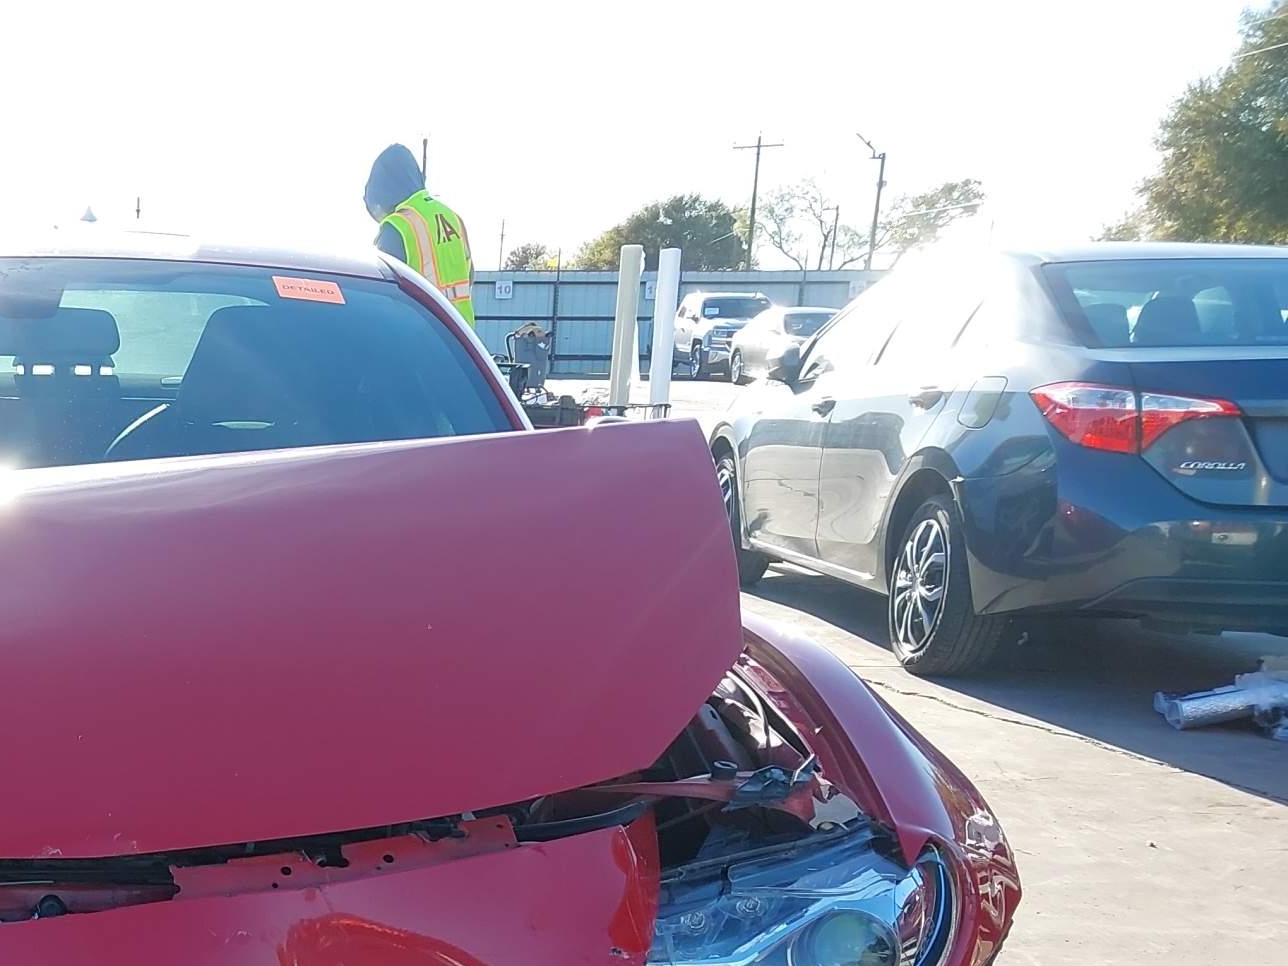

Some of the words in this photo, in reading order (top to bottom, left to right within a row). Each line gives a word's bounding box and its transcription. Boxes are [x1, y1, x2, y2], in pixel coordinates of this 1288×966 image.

[282, 284, 335, 295] DETAILED
[497, 285, 512, 294] 10
[1179, 461, 1247, 470] COROLLA
